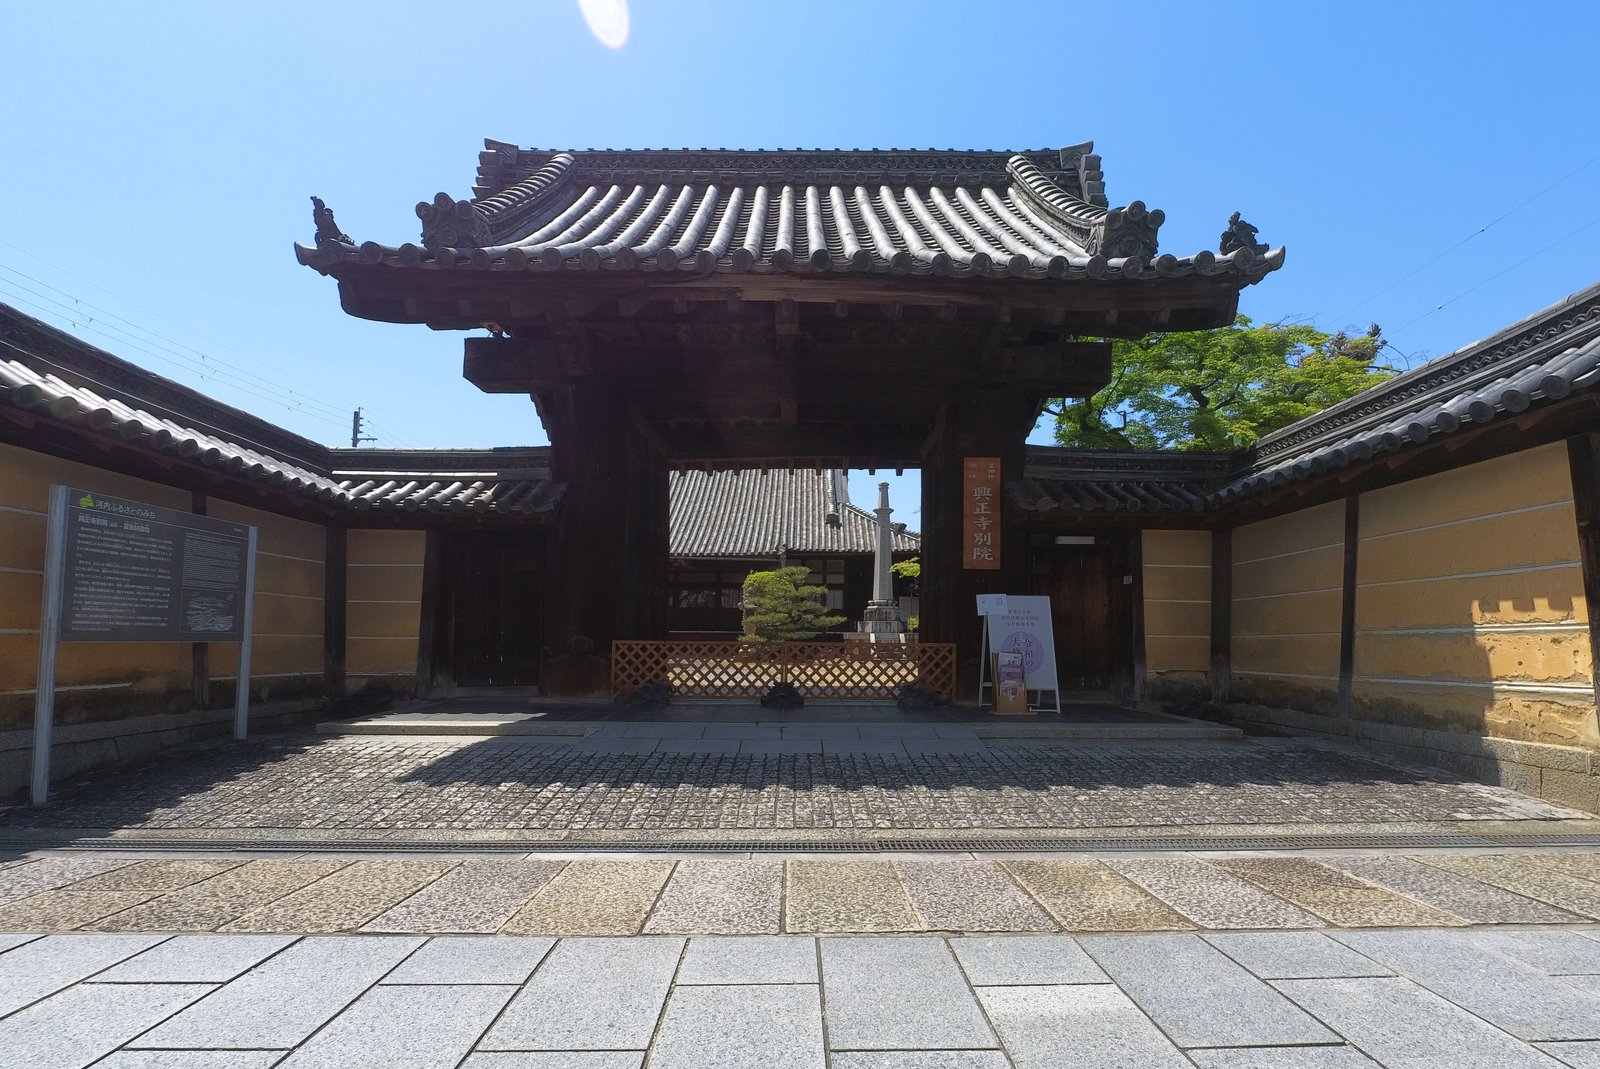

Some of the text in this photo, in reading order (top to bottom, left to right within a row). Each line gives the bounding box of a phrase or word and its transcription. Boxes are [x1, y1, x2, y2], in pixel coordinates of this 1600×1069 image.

[95, 499, 156, 519] 河内ふるさとのみち
[972, 486, 994, 561] 興正寺別院
